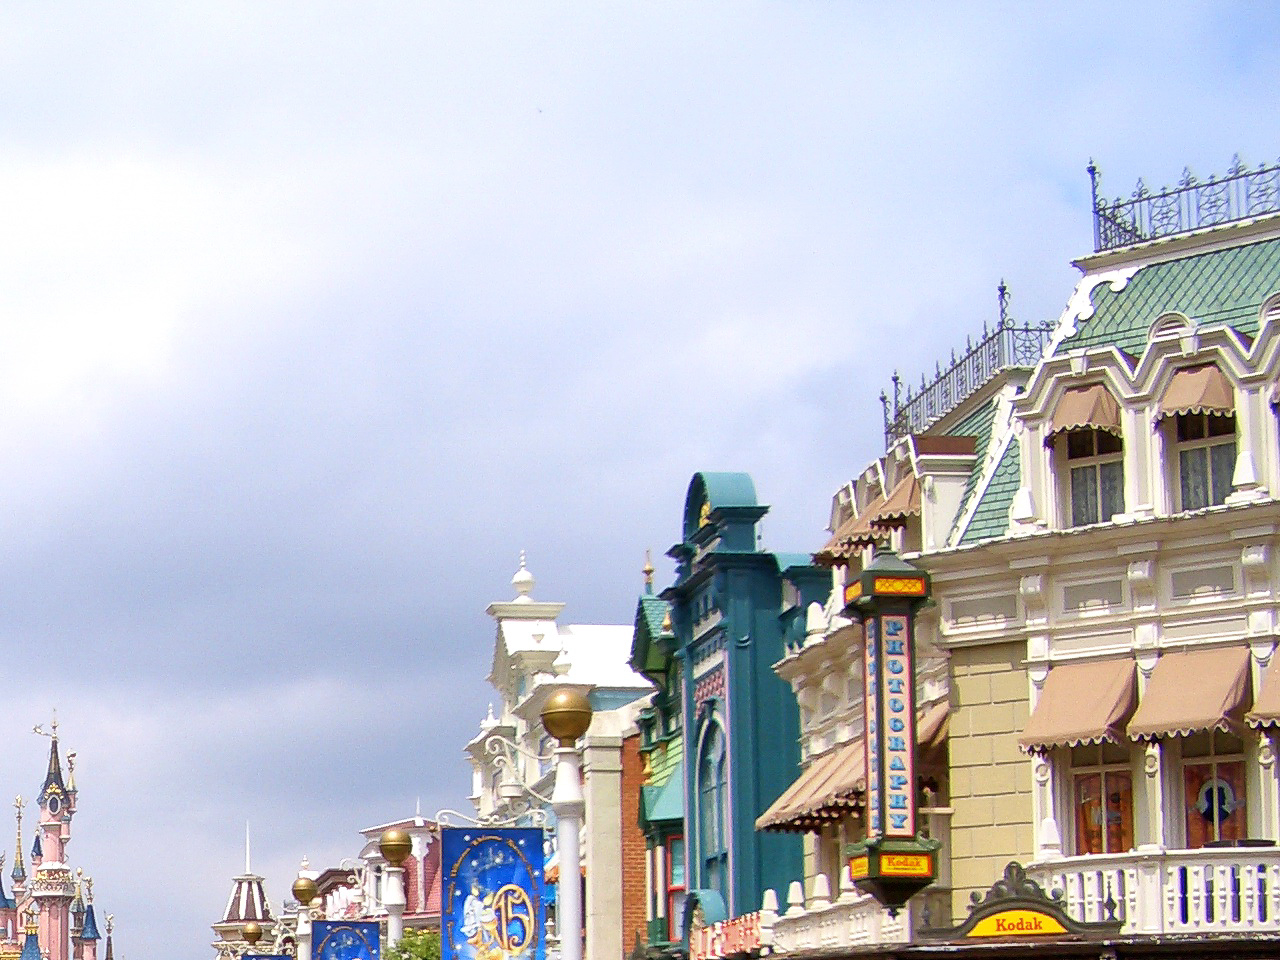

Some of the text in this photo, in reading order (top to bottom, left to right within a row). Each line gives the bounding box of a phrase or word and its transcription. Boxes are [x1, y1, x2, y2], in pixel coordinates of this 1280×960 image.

[885, 620, 908, 829] PHOTOGRAPHY
[492, 884, 534, 956] 15
[995, 917, 1043, 932] Kodak
